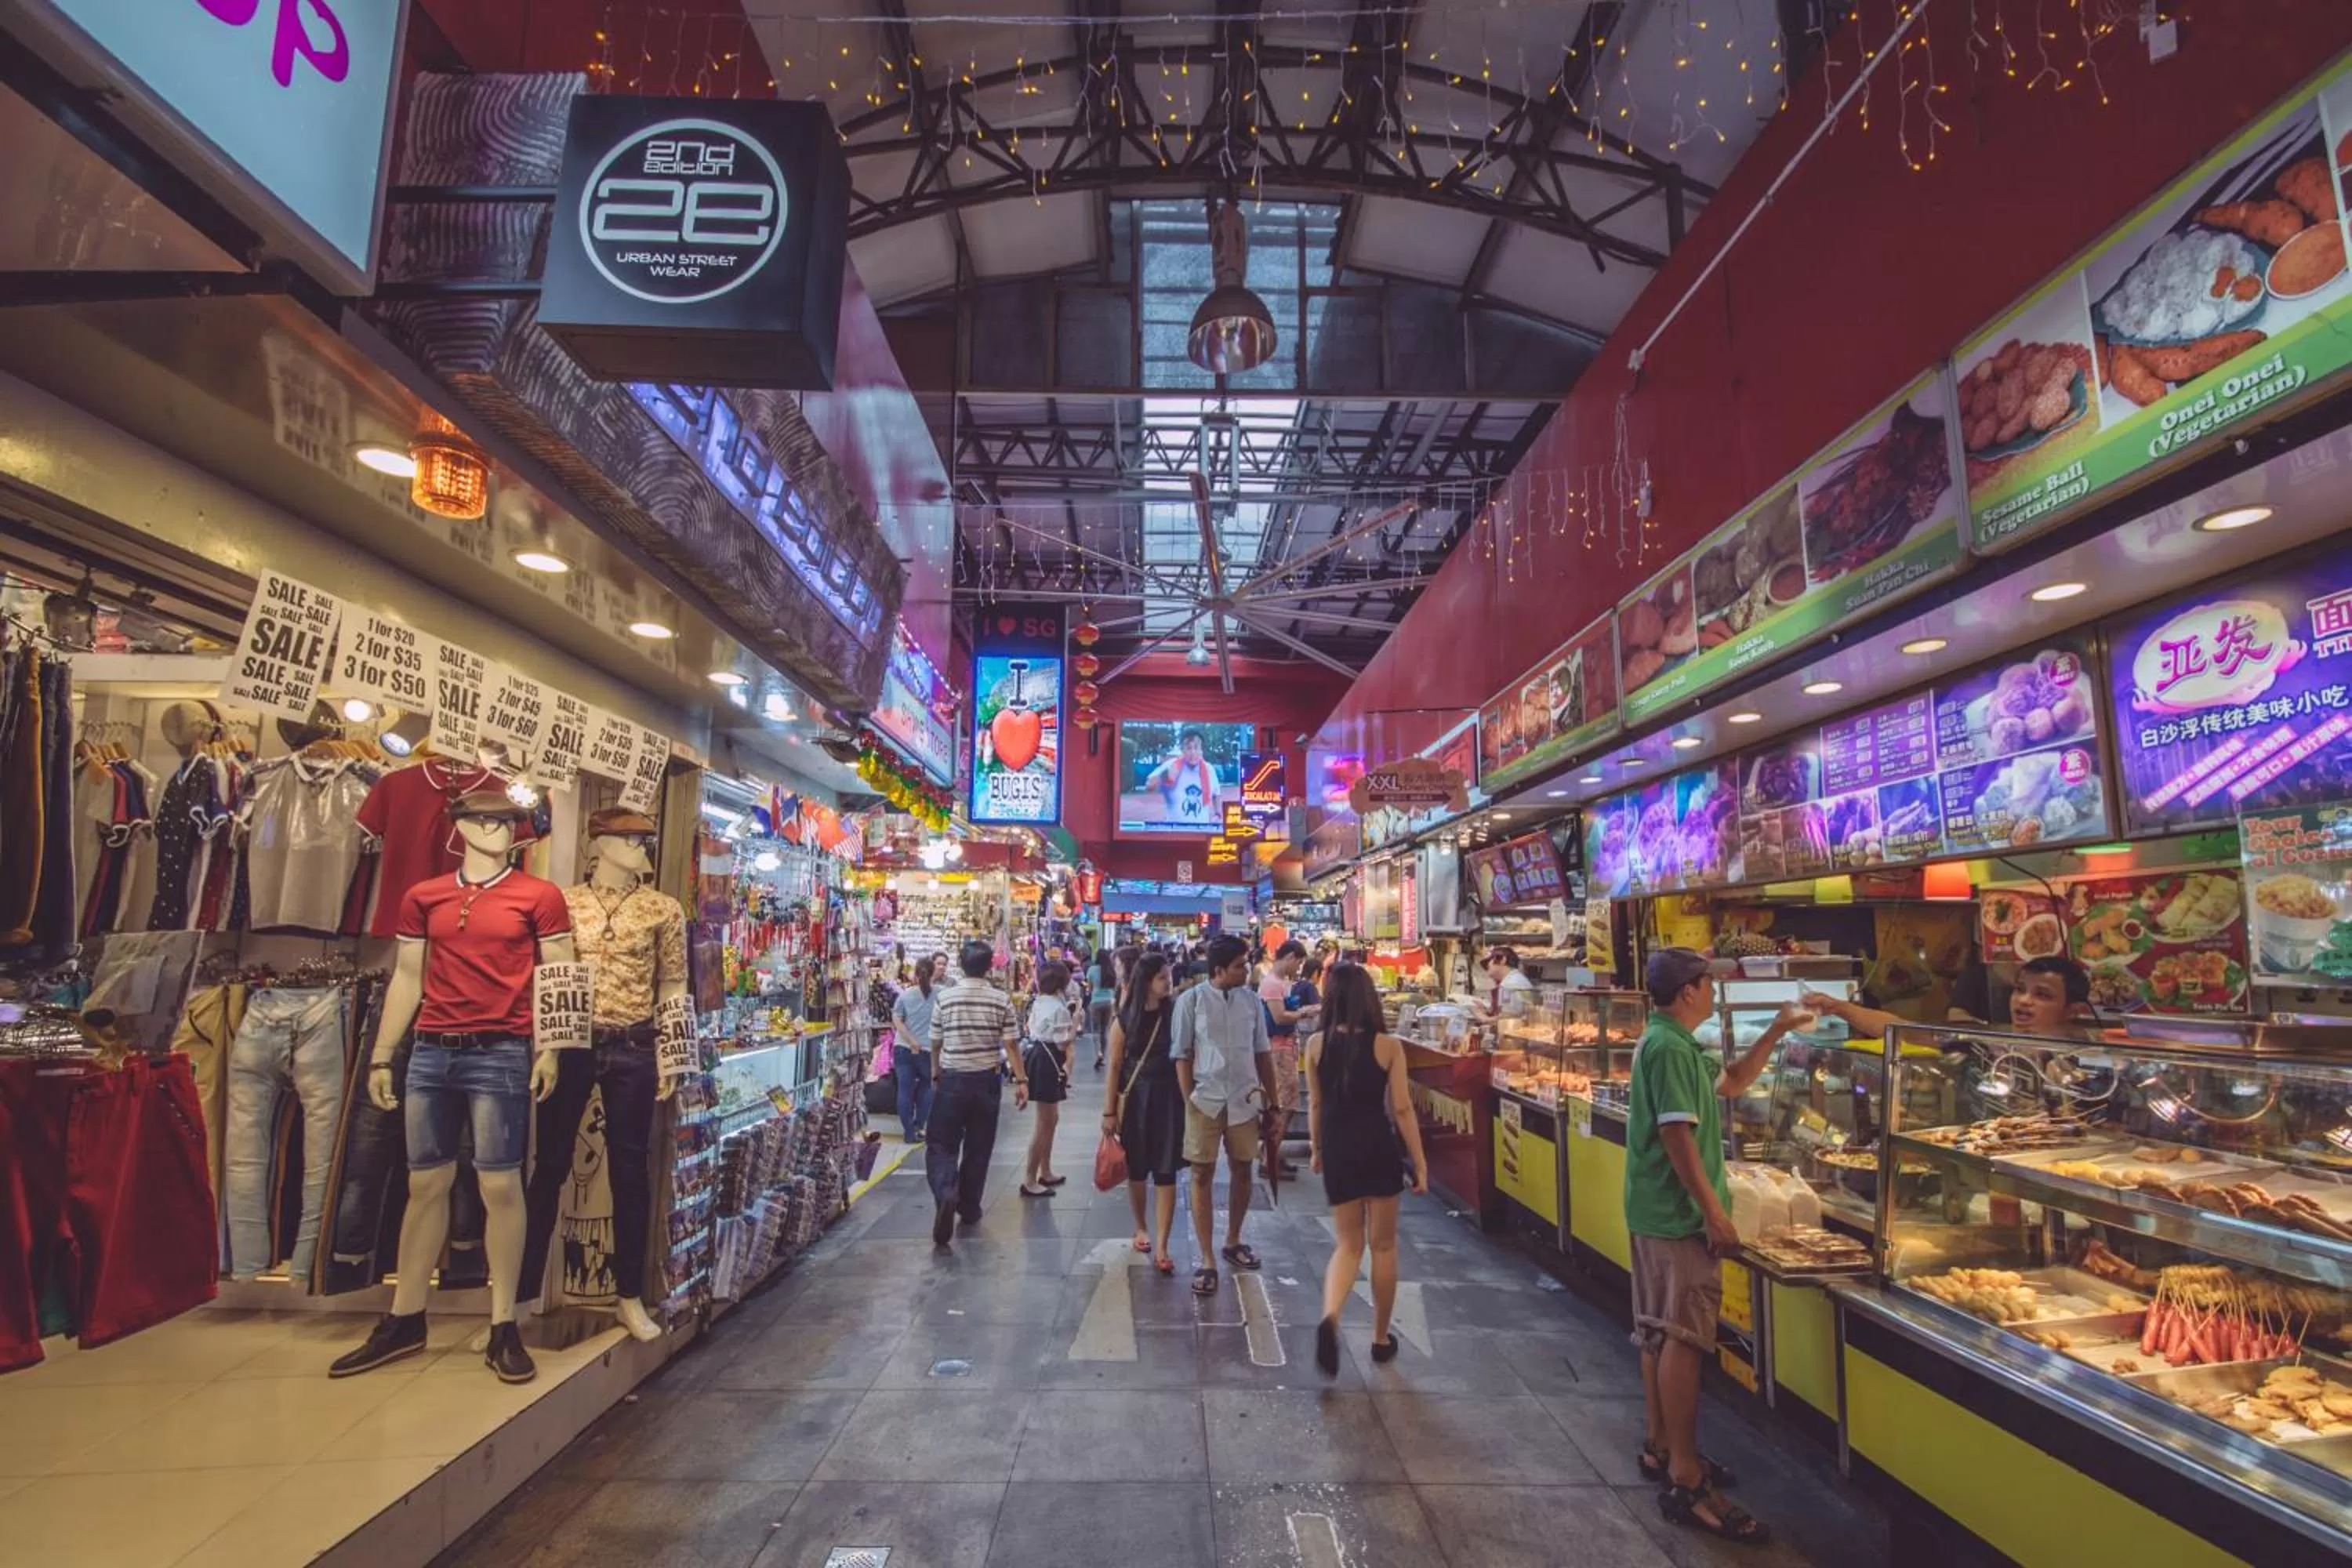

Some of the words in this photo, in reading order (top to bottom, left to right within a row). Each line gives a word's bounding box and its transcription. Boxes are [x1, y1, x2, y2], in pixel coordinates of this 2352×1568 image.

[645, 140, 735, 162] 2nd
[616, 252, 675, 265] URBAN
[679, 254, 737, 267] STREET
[650, 266, 701, 277] WEAR
[2149, 365, 2306, 458] (Vegetarian)
[1982, 486, 2043, 526] Sesame
[2046, 460, 2084, 491] Ball
[267, 577, 308, 609] SALE
[314, 593, 334, 609] SALE
[280, 607, 305, 625] SALE
[305, 604, 332, 626] SALE
[368, 617, 373, 631] 1
[376, 620, 392, 637] for
[394, 626, 416, 647] $20
[251, 617, 325, 670] SALE
[355, 632, 365, 652] 2
[368, 637, 390, 660] for
[393, 646, 422, 671] $35
[440, 644, 467, 669] SALE
[241, 656, 287, 686] SALE
[294, 670, 316, 685] SALE
[344, 655, 357, 678] 3
[359, 661, 387, 688] for
[391, 670, 426, 699] $50
[252, 685, 282, 705] SALE
[284, 682, 312, 701] SALE
[1009, 660, 1029, 708] I
[288, 699, 307, 712] SALE
[438, 679, 481, 720] SALE
[497, 688, 506, 704] 2
[506, 691, 522, 710] for
[521, 697, 543, 717] $45
[557, 694, 576, 715] SALE
[438, 710, 459, 734] SALE
[487, 705, 498, 724] 3
[496, 709, 516, 731] for
[2140, 684, 2350, 749] 白沙浮传统美味小吃
[444, 733, 459, 750] SALE
[549, 724, 585, 757] SALE
[542, 750, 568, 769] SALE
[590, 742, 599, 759] 3
[598, 746, 612, 763] for
[548, 768, 566, 782] SALE
[637, 755, 663, 782] SALE
[990, 775, 1041, 800] BUGIS
[1367, 775, 1400, 791] XXL
[2244, 815, 2302, 833] Your
[540, 965, 570, 980] SALE
[539, 990, 590, 1015] SALE
[656, 996, 681, 1017] SALE
[539, 1014, 572, 1031] SALE
[551, 1031, 573, 1042] SALE
